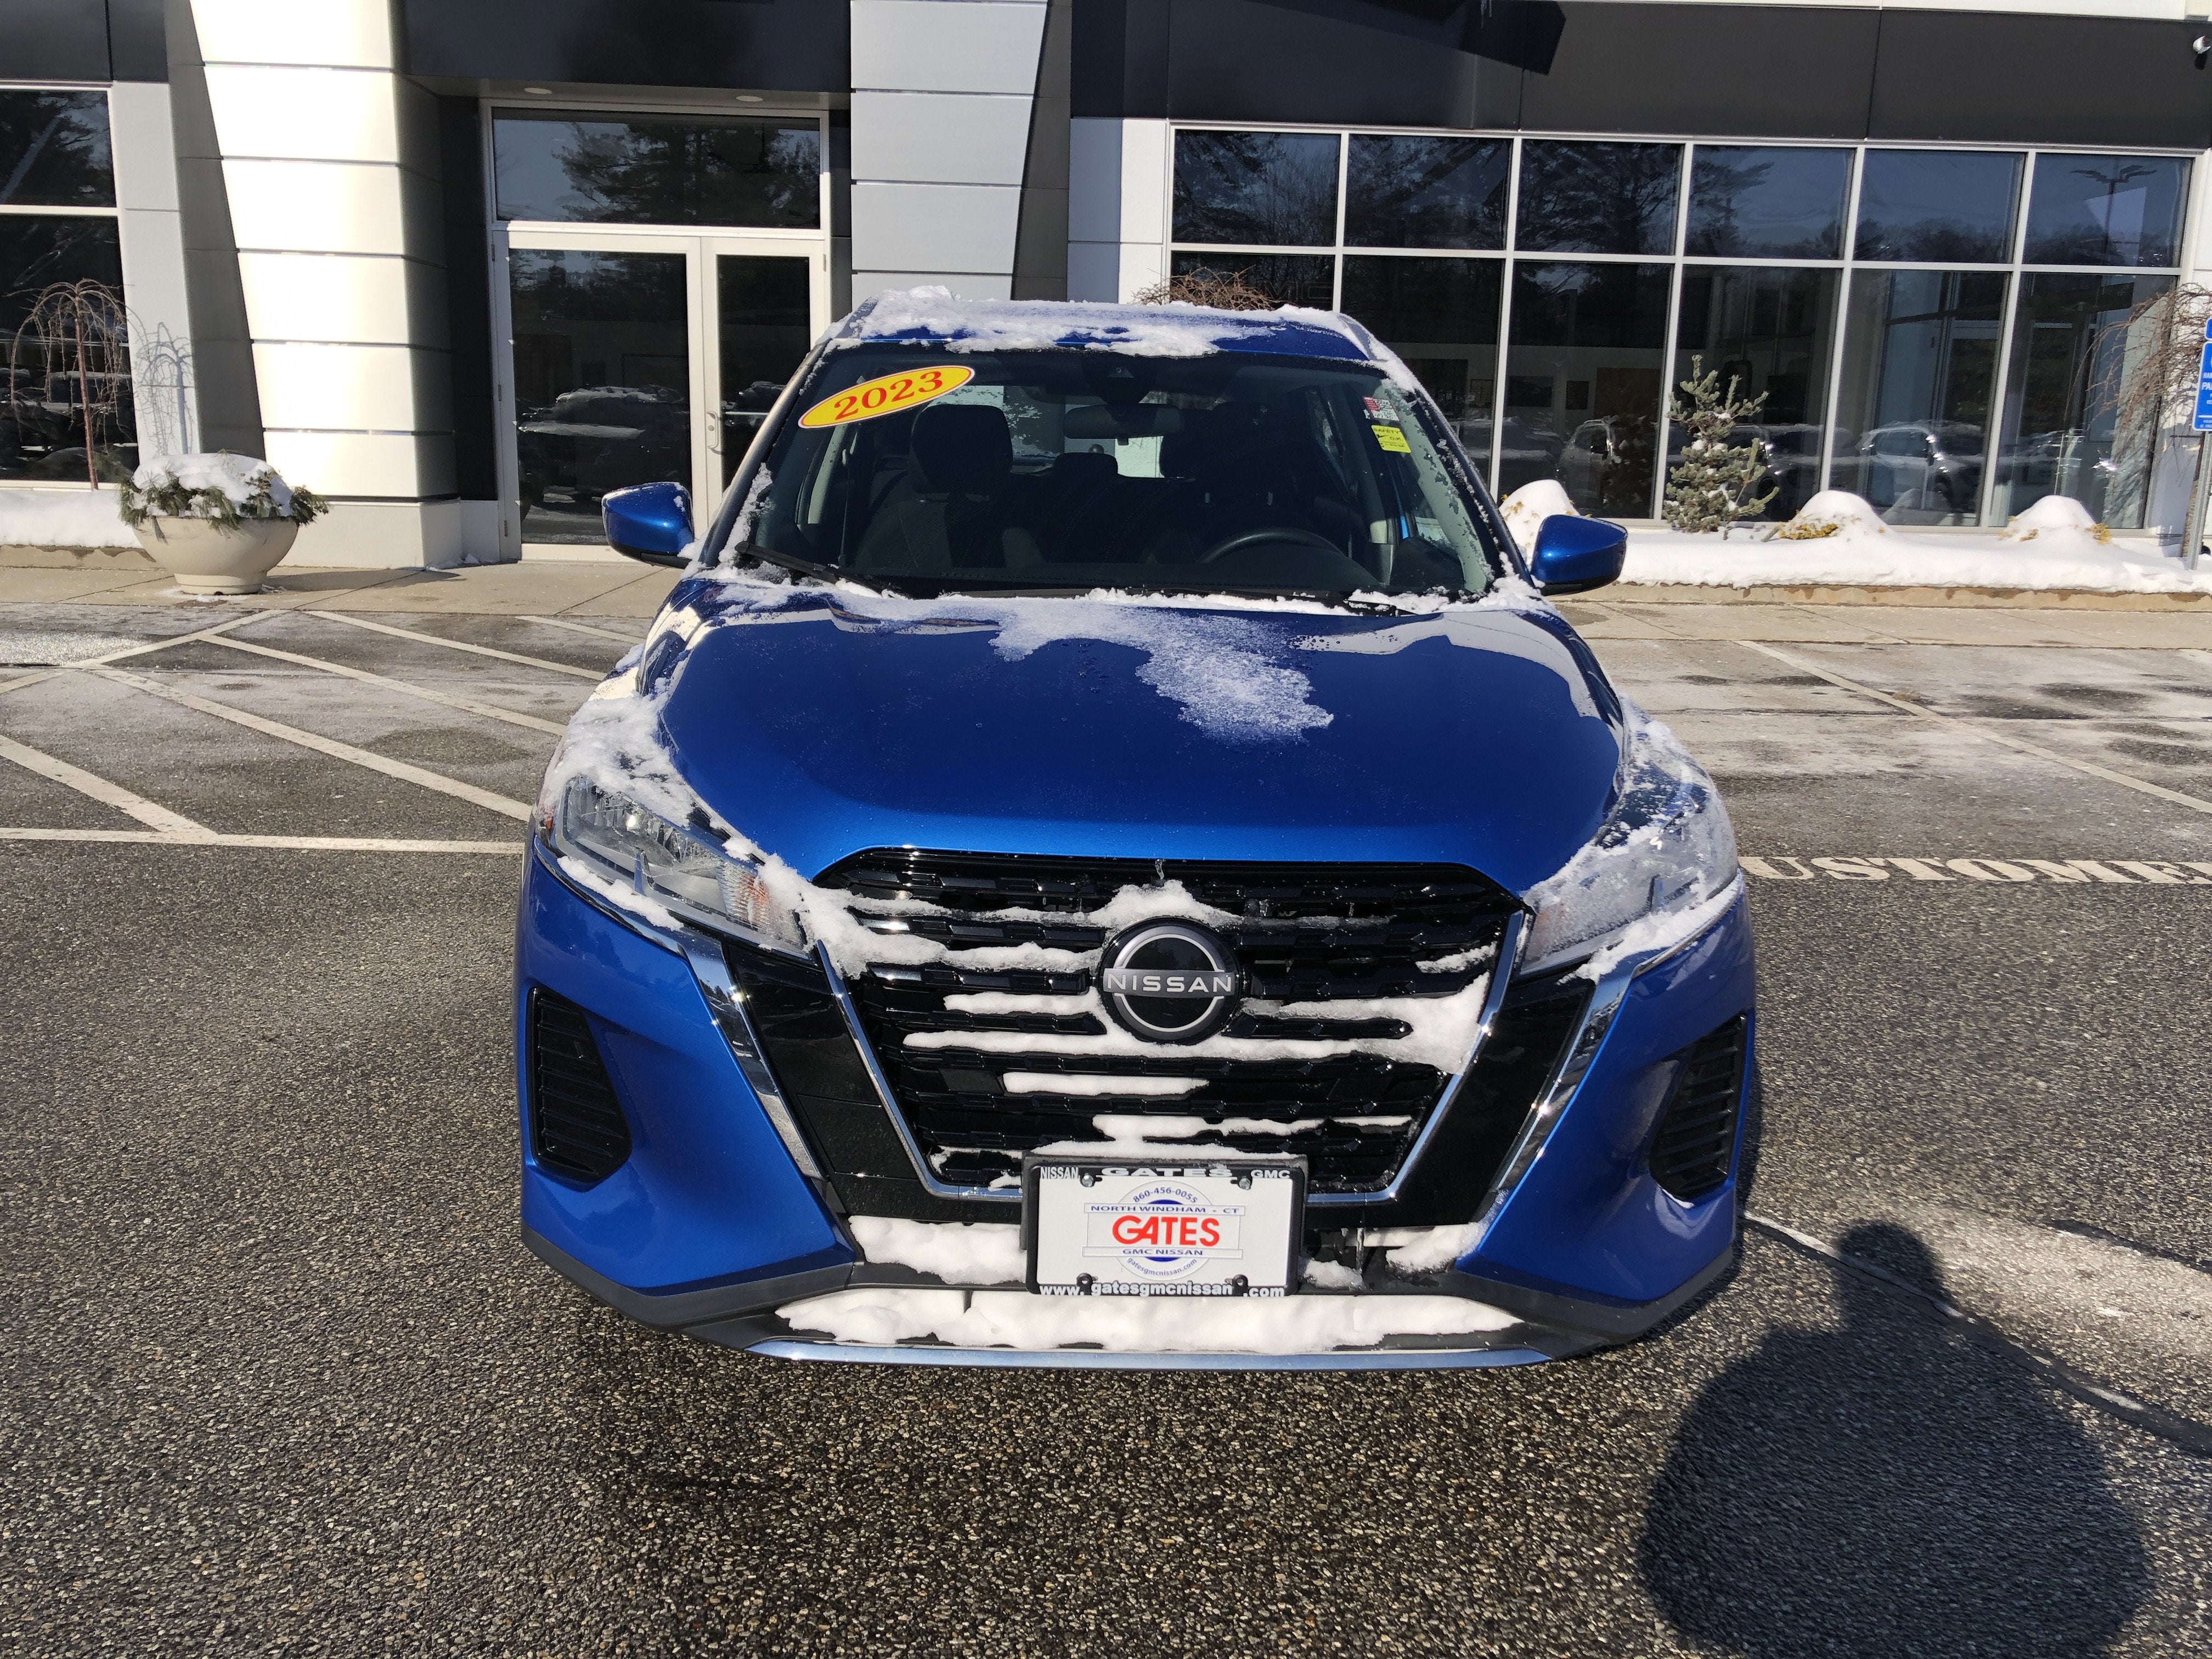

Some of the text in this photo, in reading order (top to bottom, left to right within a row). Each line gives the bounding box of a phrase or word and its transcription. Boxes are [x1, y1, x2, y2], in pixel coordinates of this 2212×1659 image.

[834, 371, 943, 421] 2023
[1107, 973, 1232, 993] NISSAN
[1040, 1166, 1290, 1180] NISSAN GATES GMC
[1132, 1187, 1198, 1203] 860-456-0055
[1112, 1215, 1220, 1246] GATES
[1127, 1257, 1197, 1276] gatesgmcnissan.com
[1040, 1280, 1285, 1297] www. gatesgmcnissan .com
